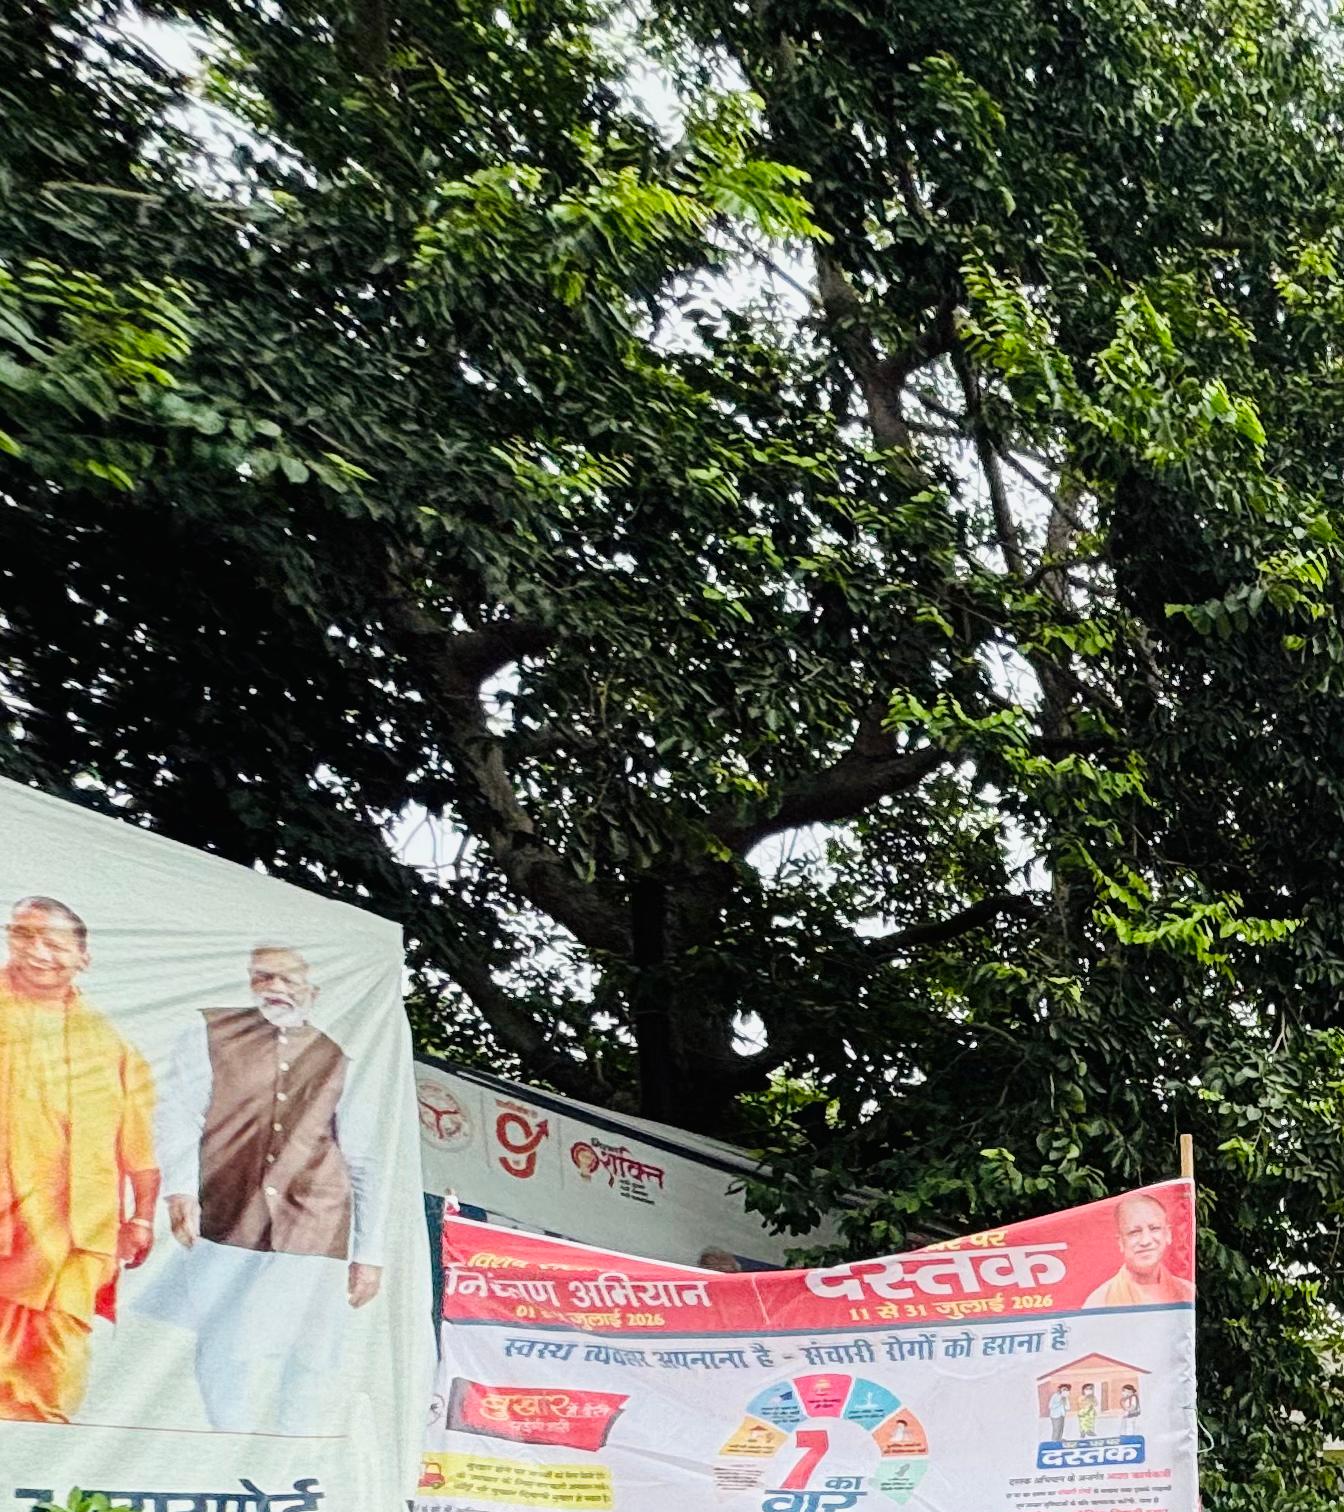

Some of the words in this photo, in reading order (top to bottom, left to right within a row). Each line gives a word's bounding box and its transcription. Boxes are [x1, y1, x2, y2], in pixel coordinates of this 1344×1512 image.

[1012, 1293, 1053, 1310] 2026
[944, 1332, 975, 1360] को
[981, 1328, 1046, 1357] हराना
[1052, 1322, 1070, 1351] है
[779, 1430, 829, 1490] 7
[1042, 1443, 1140, 1466] दस्तक
[824, 1476, 865, 1490] का
